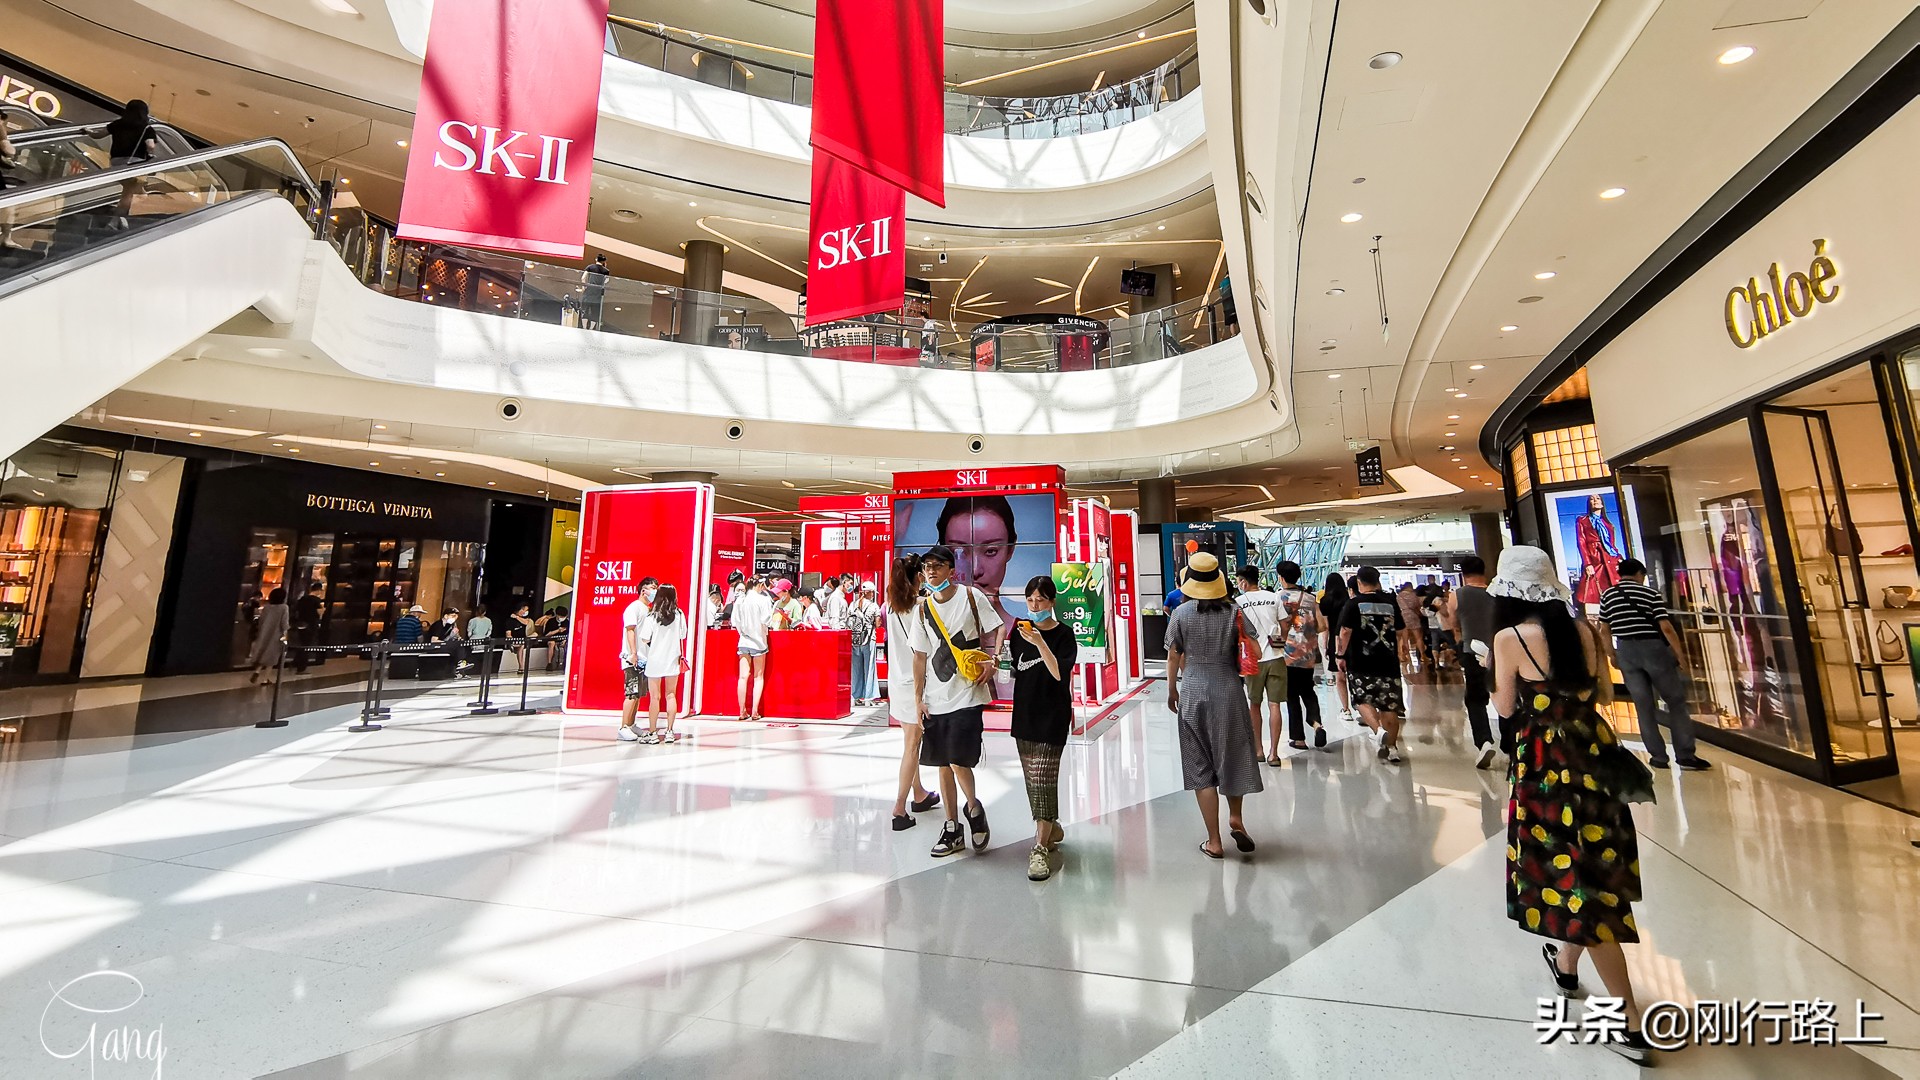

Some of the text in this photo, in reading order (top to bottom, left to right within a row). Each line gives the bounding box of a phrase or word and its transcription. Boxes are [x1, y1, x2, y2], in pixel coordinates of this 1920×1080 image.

[433, 120, 574, 186] SK-II
[817, 216, 892, 270] SK-II
[1725, 238, 1840, 349] Chloé
[1058, 317, 1098, 329] GIVENCHY
[956, 469, 988, 486] SK-II
[306, 493, 433, 519] BOTTEGA VENETA
[864, 495, 889, 508] SK-II
[596, 560, 632, 581] SK-II
[594, 585, 638, 595] SKIN TRAI
[593, 596, 616, 606] CAMP
